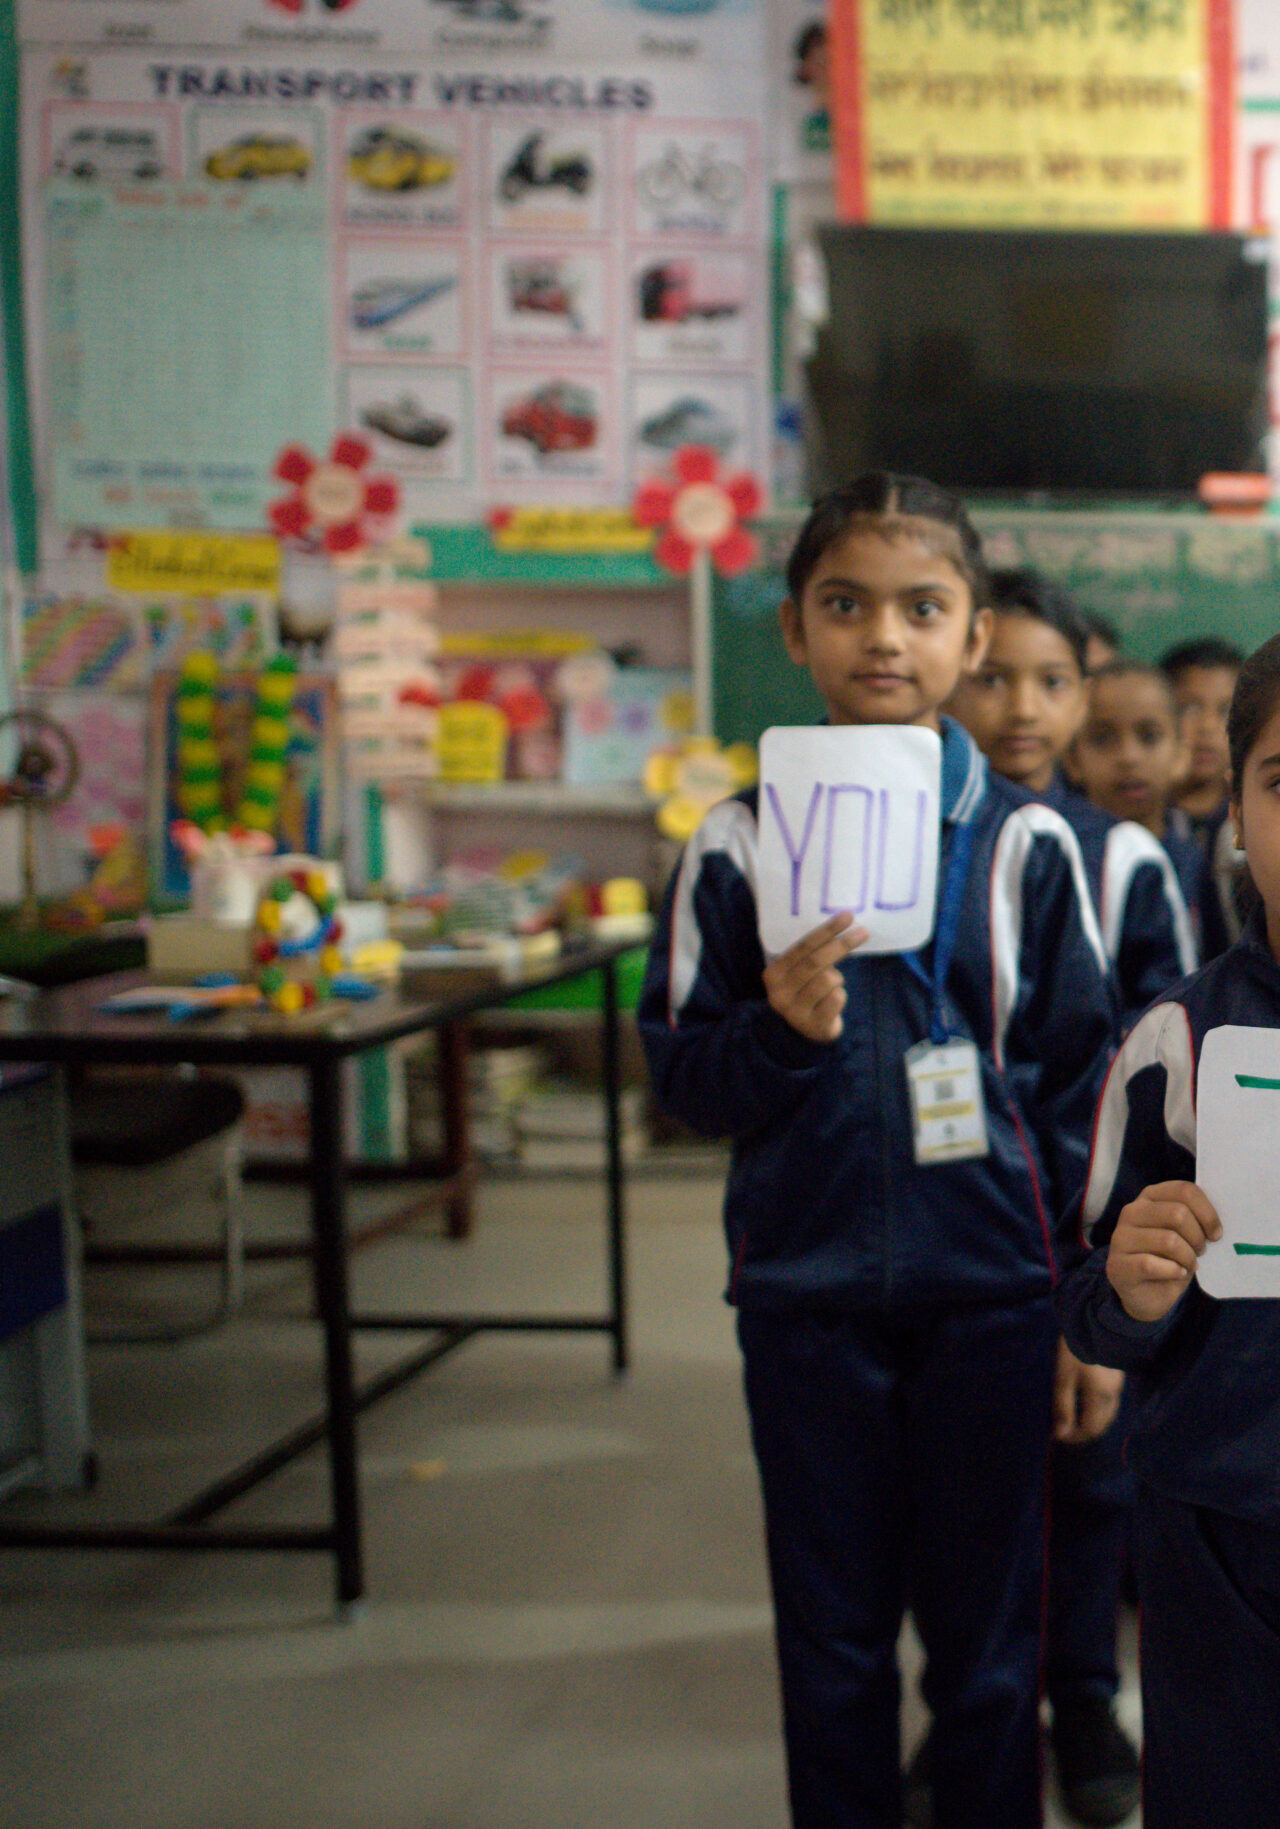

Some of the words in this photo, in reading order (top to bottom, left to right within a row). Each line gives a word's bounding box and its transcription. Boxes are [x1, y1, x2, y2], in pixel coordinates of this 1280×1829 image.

[150, 64, 418, 101] TRANSPORT
[431, 73, 655, 110] VEHICLES
[765, 781, 927, 916] YOU
